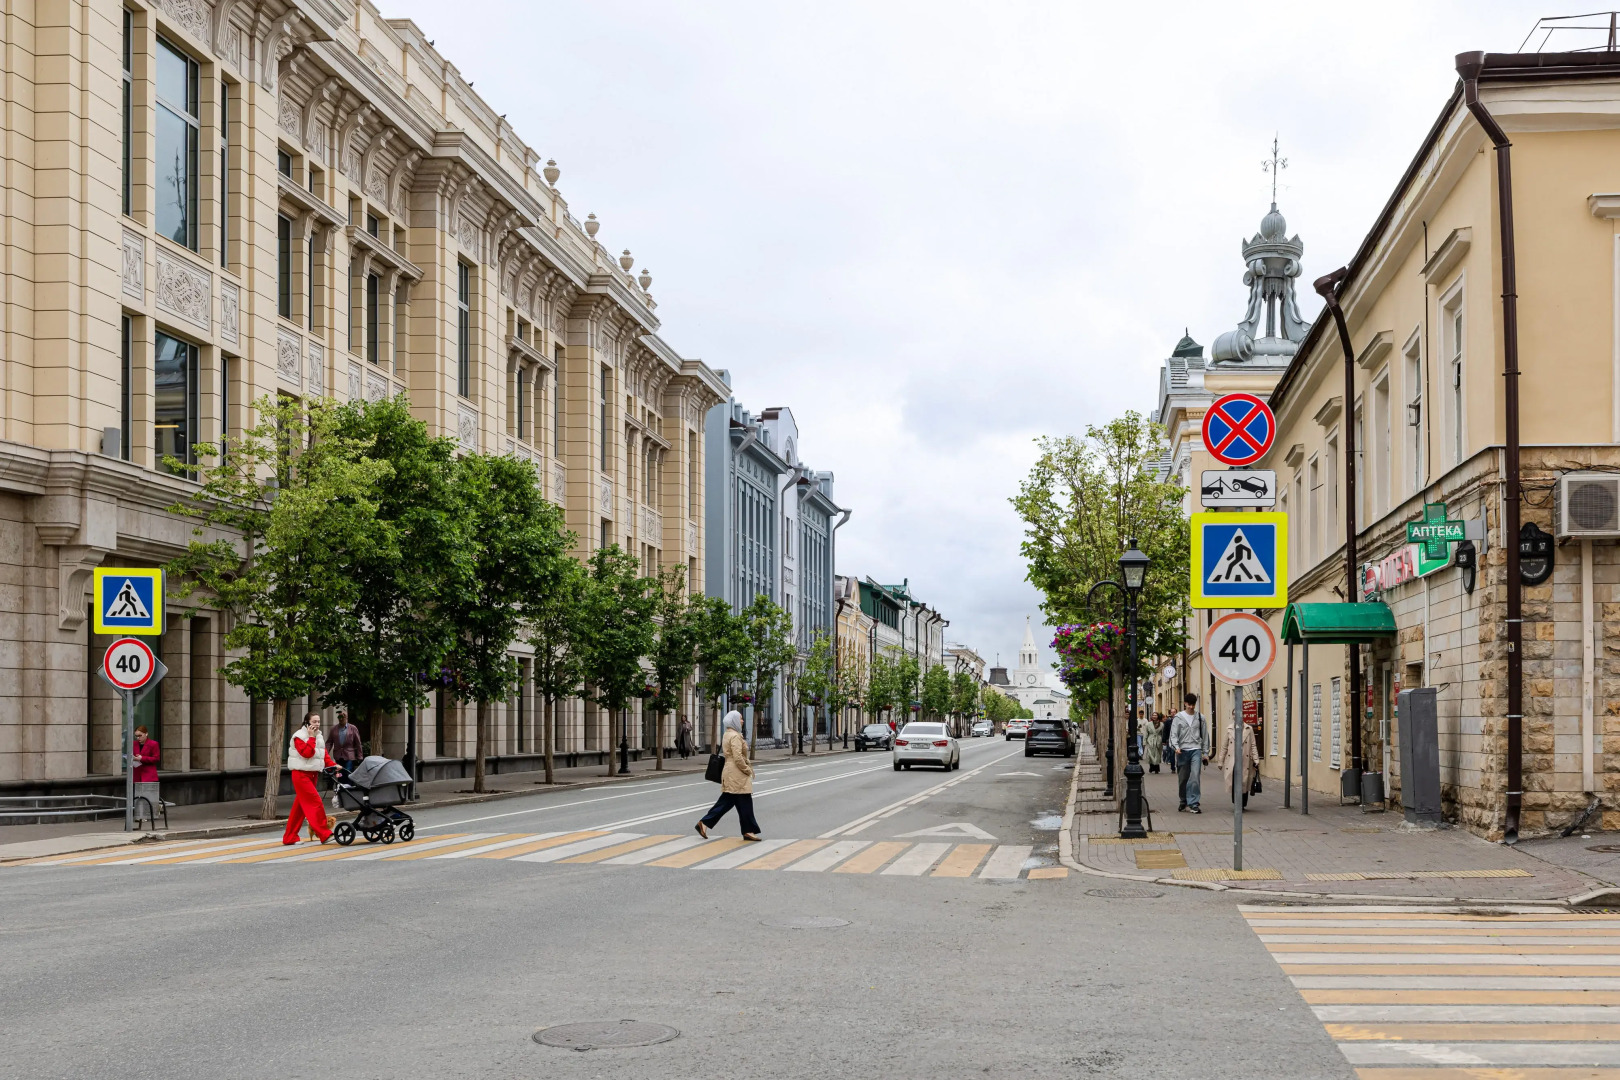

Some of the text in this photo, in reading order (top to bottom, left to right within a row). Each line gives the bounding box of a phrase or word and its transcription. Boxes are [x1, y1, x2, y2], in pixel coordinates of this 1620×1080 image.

[1411, 525, 1462, 537] АПТЕКА
[1521, 543, 1530, 551] 17
[1218, 634, 1261, 663] 40
[115, 654, 141, 673] 40
